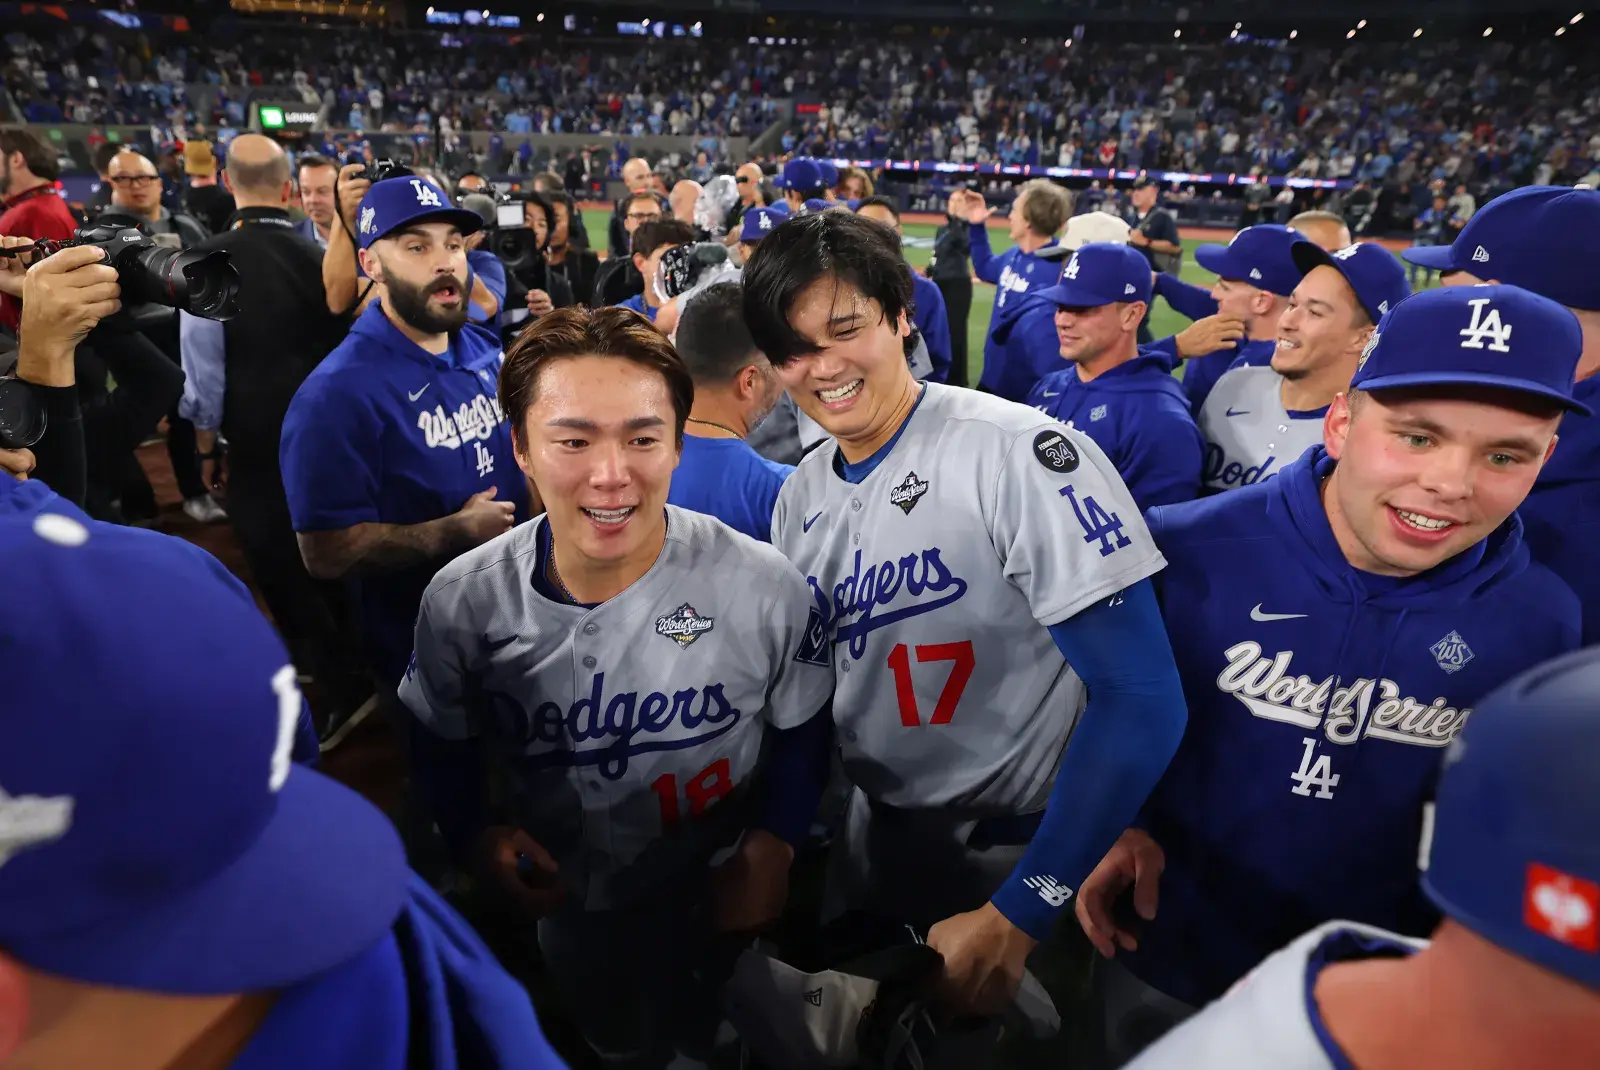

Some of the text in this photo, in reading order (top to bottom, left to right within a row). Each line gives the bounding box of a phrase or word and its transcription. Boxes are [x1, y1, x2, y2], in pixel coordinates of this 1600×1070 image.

[409, 180, 442, 207] LA
[759, 211, 772, 229] LA
[1063, 252, 1080, 280] LA
[1459, 298, 1512, 353] LA
[418, 400, 480, 450] World
[474, 441, 494, 477] LA
[1037, 436, 1062, 451] FERNANDO
[1046, 443, 1075, 467] 34
[1058, 484, 1132, 557] LA
[657, 617, 712, 635] World Series
[1437, 641, 1468, 665] WS
[888, 640, 976, 727] 17
[1217, 640, 1475, 747] World Series
[484, 672, 741, 780] Dodgers
[1291, 737, 1341, 800] LA
